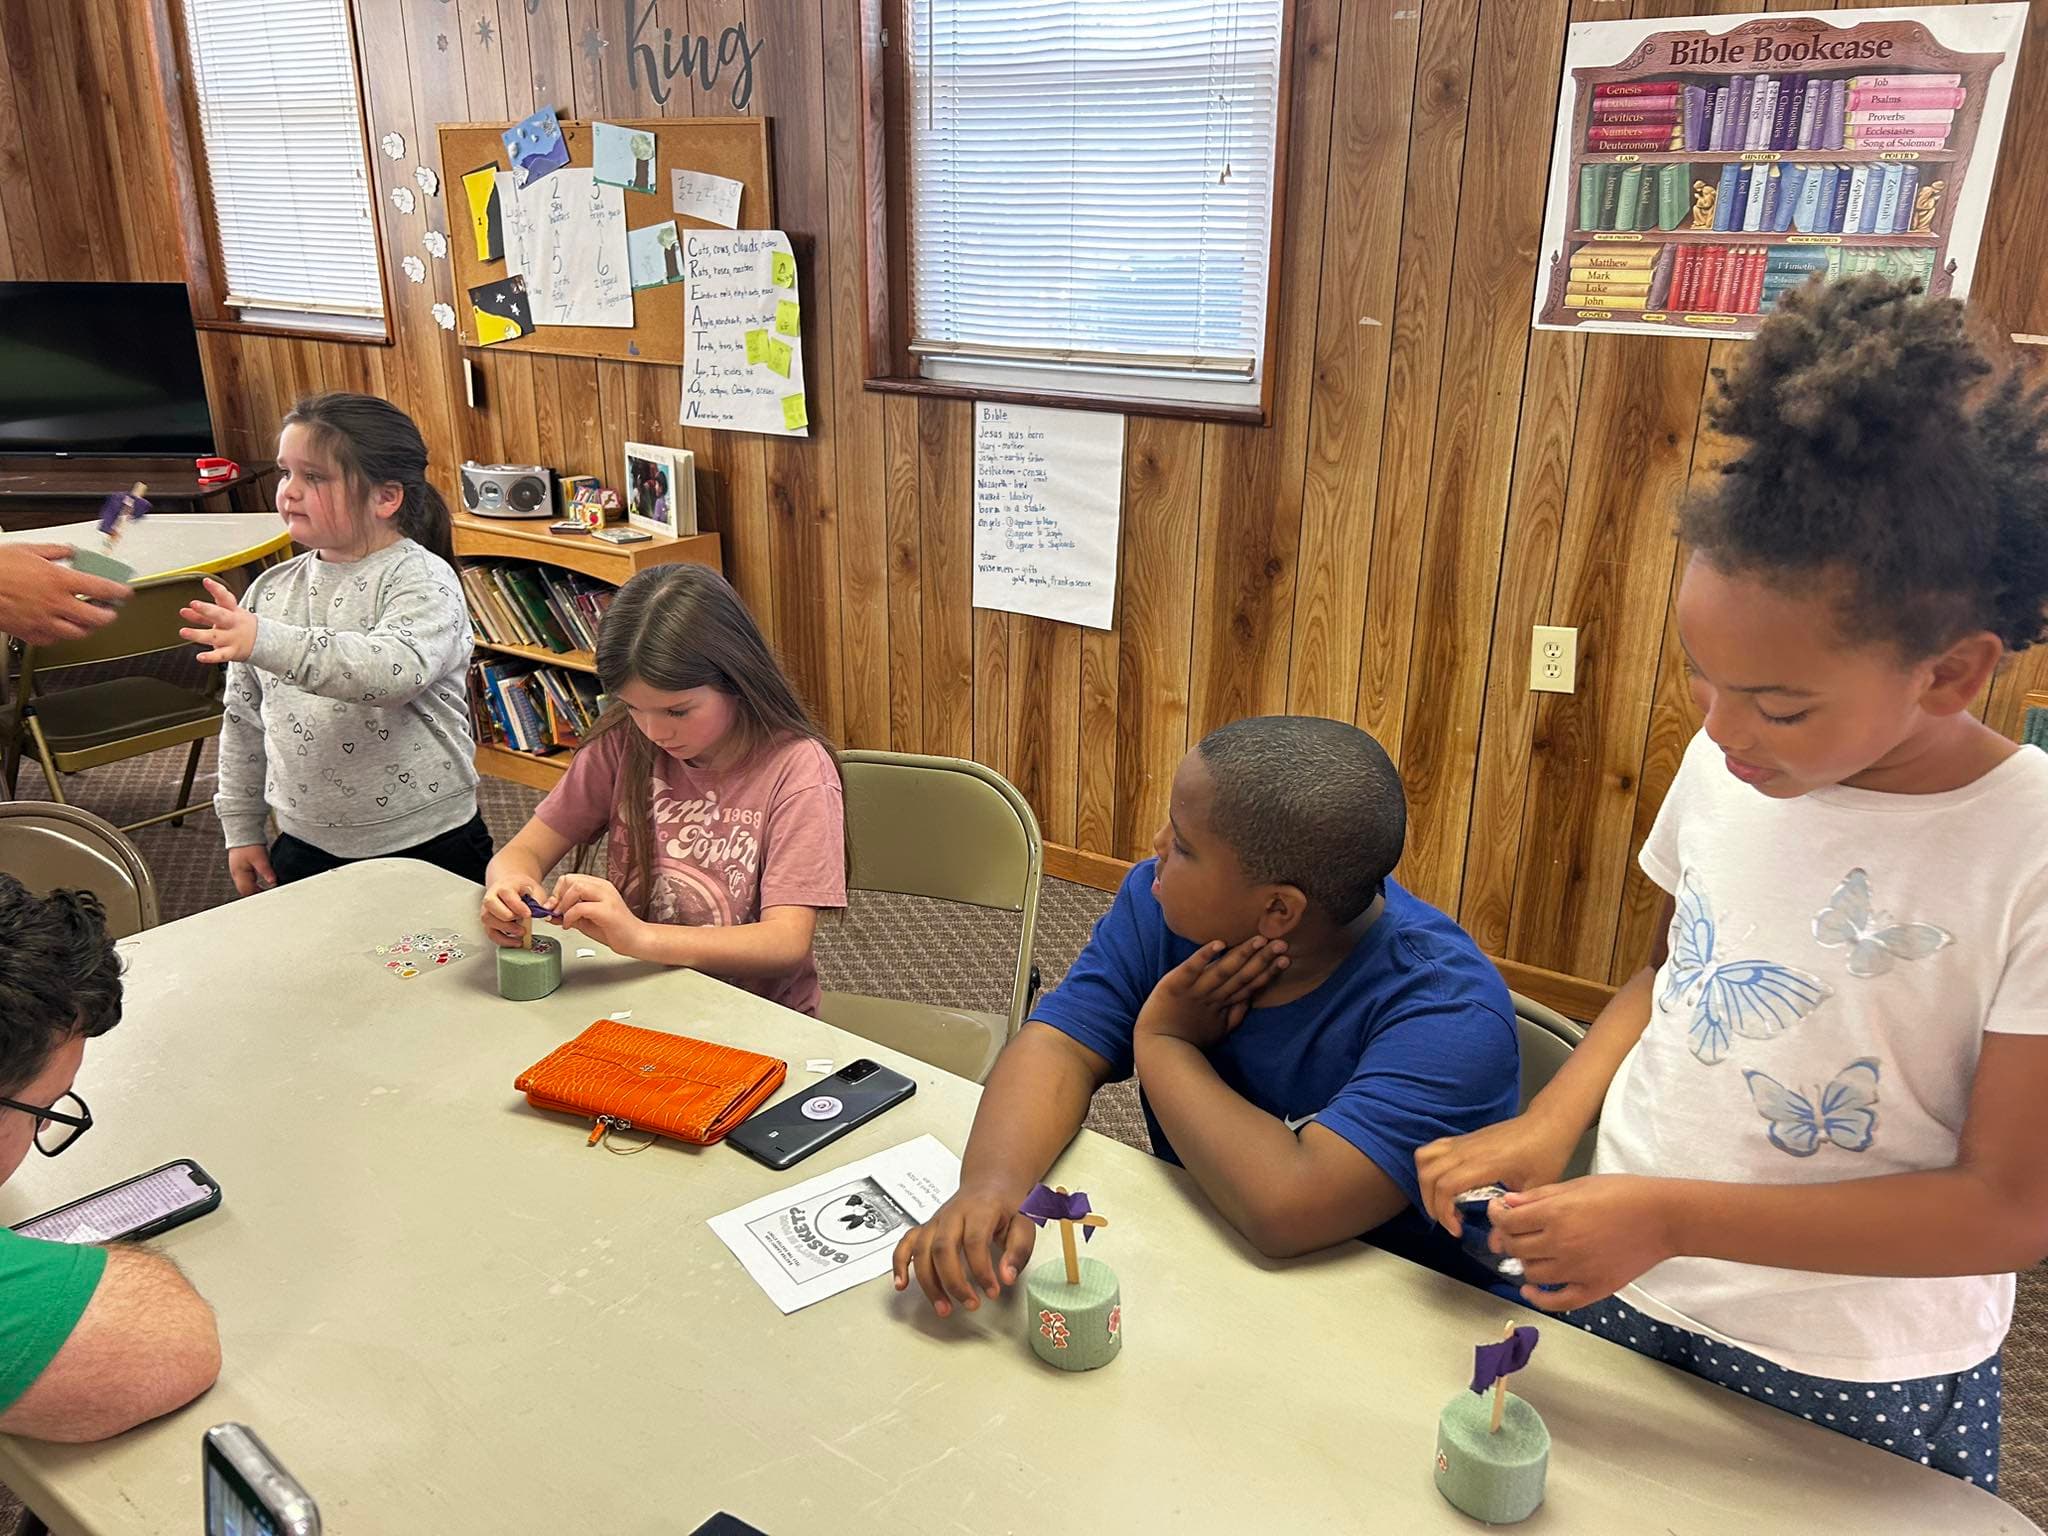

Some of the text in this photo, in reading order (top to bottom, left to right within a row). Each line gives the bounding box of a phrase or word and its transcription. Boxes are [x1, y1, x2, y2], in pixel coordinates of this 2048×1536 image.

[1669, 34, 1893, 65] Bible Bookcase
[1606, 85, 1642, 94] Genesis
[1874, 78, 1888, 88] Job
[1704, 92, 1716, 119] Judges
[1715, 95, 1726, 115] Ruth
[1751, 96, 1763, 120] Kings
[1763, 96, 1776, 120] Kings
[1871, 95, 1901, 104] Psalms
[1603, 113, 1644, 122] Leviticus
[1773, 96, 1788, 138] Chronicles
[1787, 95, 1801, 138] Chronicles
[1868, 113, 1905, 121] Proverbs
[1602, 128, 1643, 136] Numbers
[1865, 127, 1915, 136] Ecclesiastes
[1599, 140, 1659, 151] Deuteronomy
[1863, 140, 1885, 149] Song
[1897, 139, 1936, 147] Solomon
[551, 176, 560, 199] 2
[1753, 180, 1763, 203] Amos
[1806, 179, 1818, 205] Micah
[1850, 179, 1865, 222] Zephaniah
[1881, 179, 1897, 220] Zechariah
[520, 253, 531, 275] 4
[598, 246, 609, 276] 6
[1588, 258, 1628, 267] Matthew
[1587, 271, 1610, 280] Mark
[1586, 284, 1608, 292] Luke
[1584, 297, 1604, 306] John
[555, 304, 568, 323] 7
[984, 408, 1008, 420] Bible
[979, 425, 1044, 439] Jesus was born
[722, 807, 762, 829] 1969
[666, 824, 758, 873] Joplin
[789, 1207, 849, 1264] BASKET?
